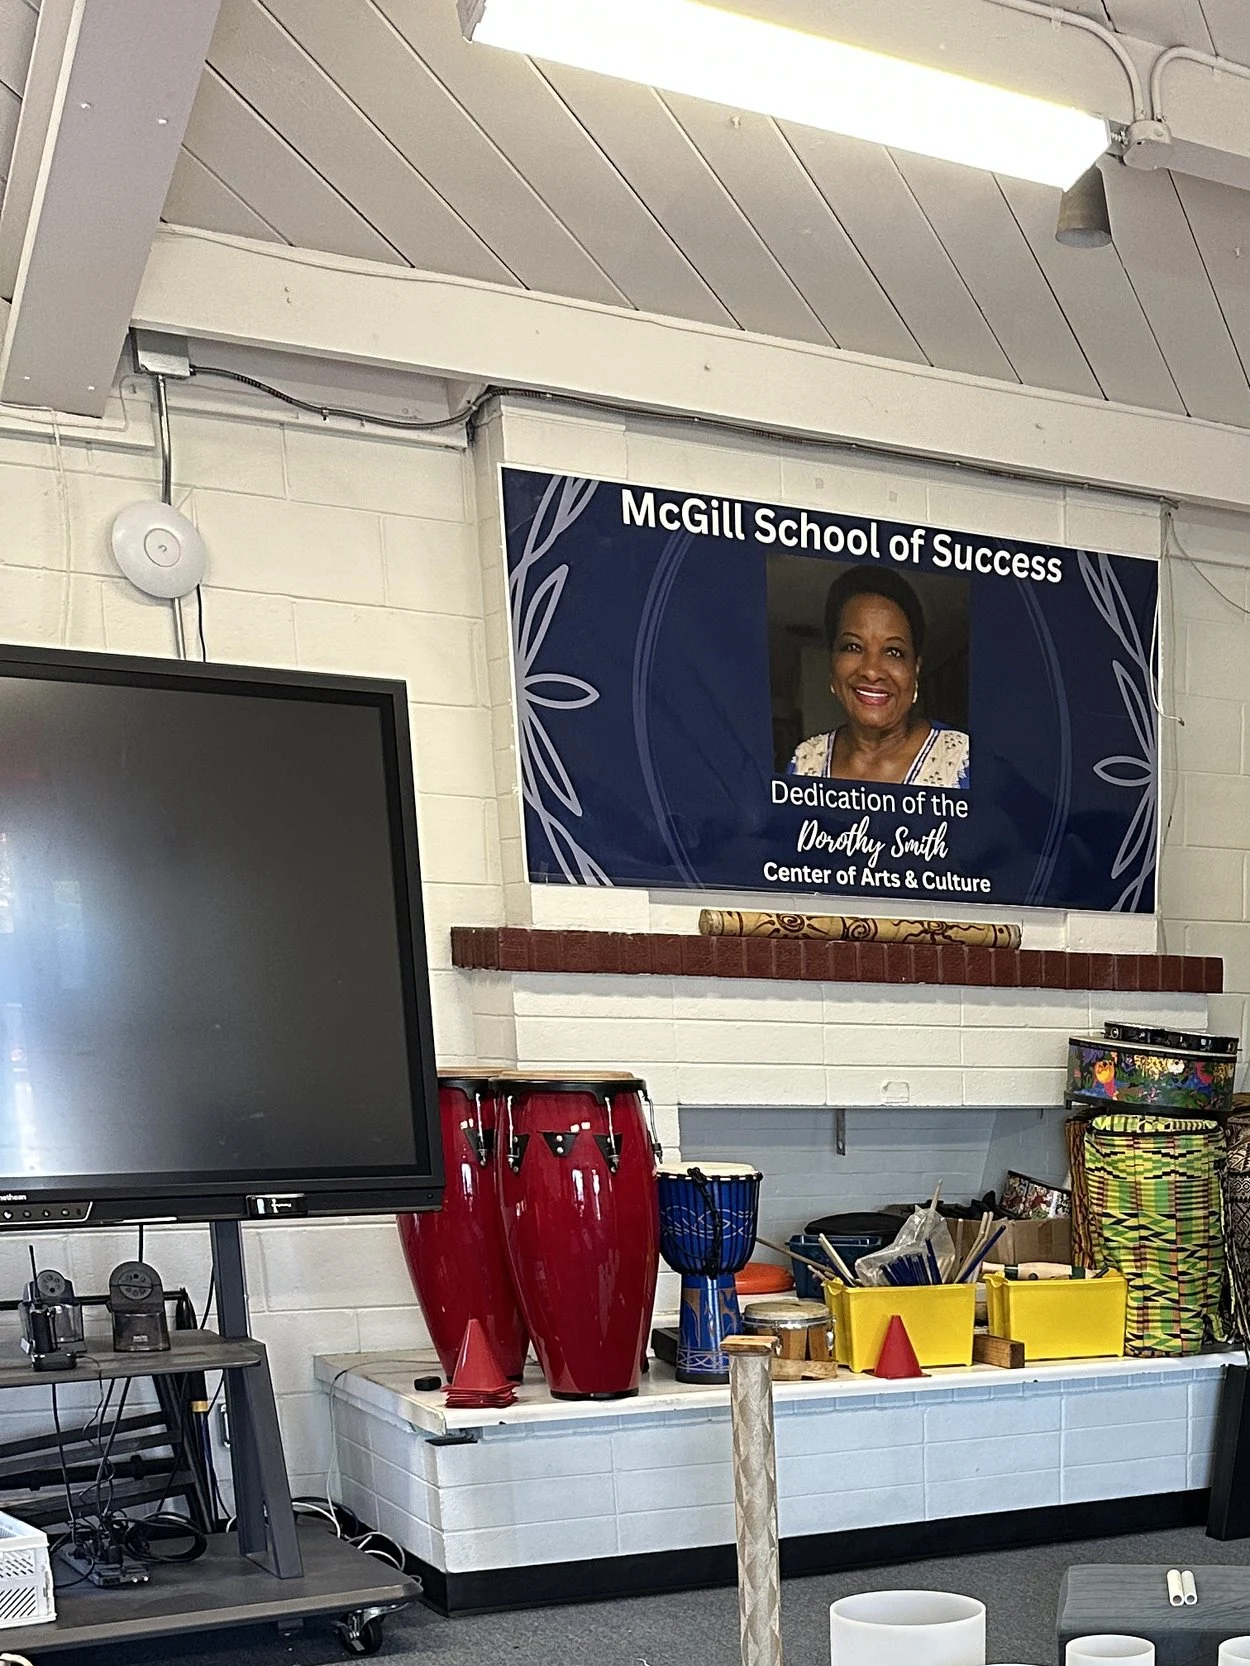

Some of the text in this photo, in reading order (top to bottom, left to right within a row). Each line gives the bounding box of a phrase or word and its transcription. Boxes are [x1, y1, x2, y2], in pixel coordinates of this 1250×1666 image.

[622, 488, 1062, 583] McGill School of Success
[770, 779, 968, 818] Dedication of the
[797, 815, 949, 868] Dorothy Smith
[763, 861, 991, 893] Center of Arts & Culture
